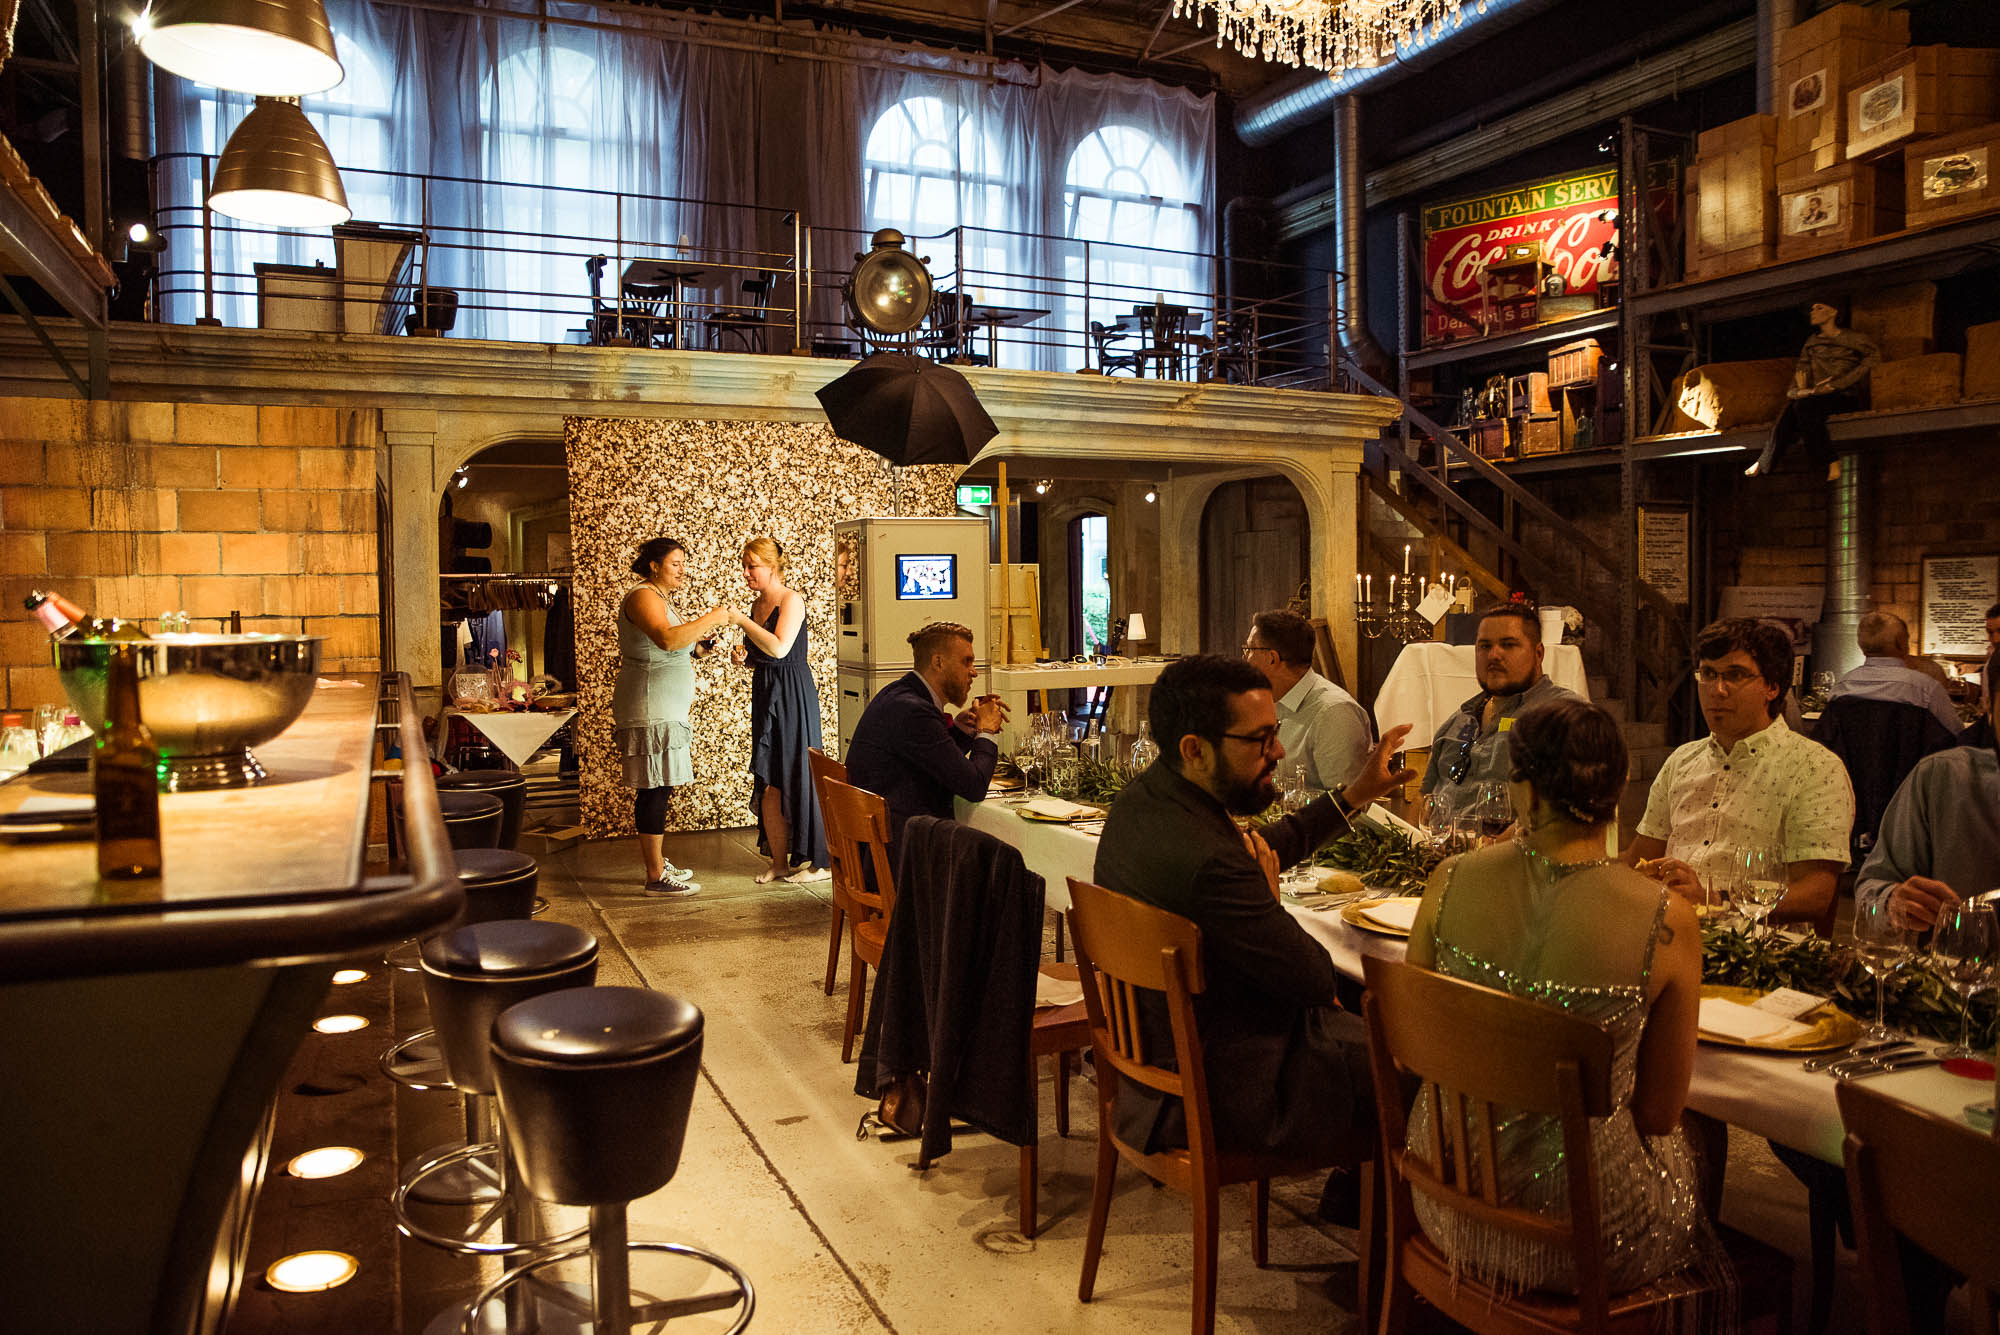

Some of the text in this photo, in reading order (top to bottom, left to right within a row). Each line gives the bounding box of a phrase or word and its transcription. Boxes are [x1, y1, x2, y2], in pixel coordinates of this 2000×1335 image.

[1440, 176, 1614, 227] FOUNTAIN SERV
[1485, 218, 1555, 242] DRINK
